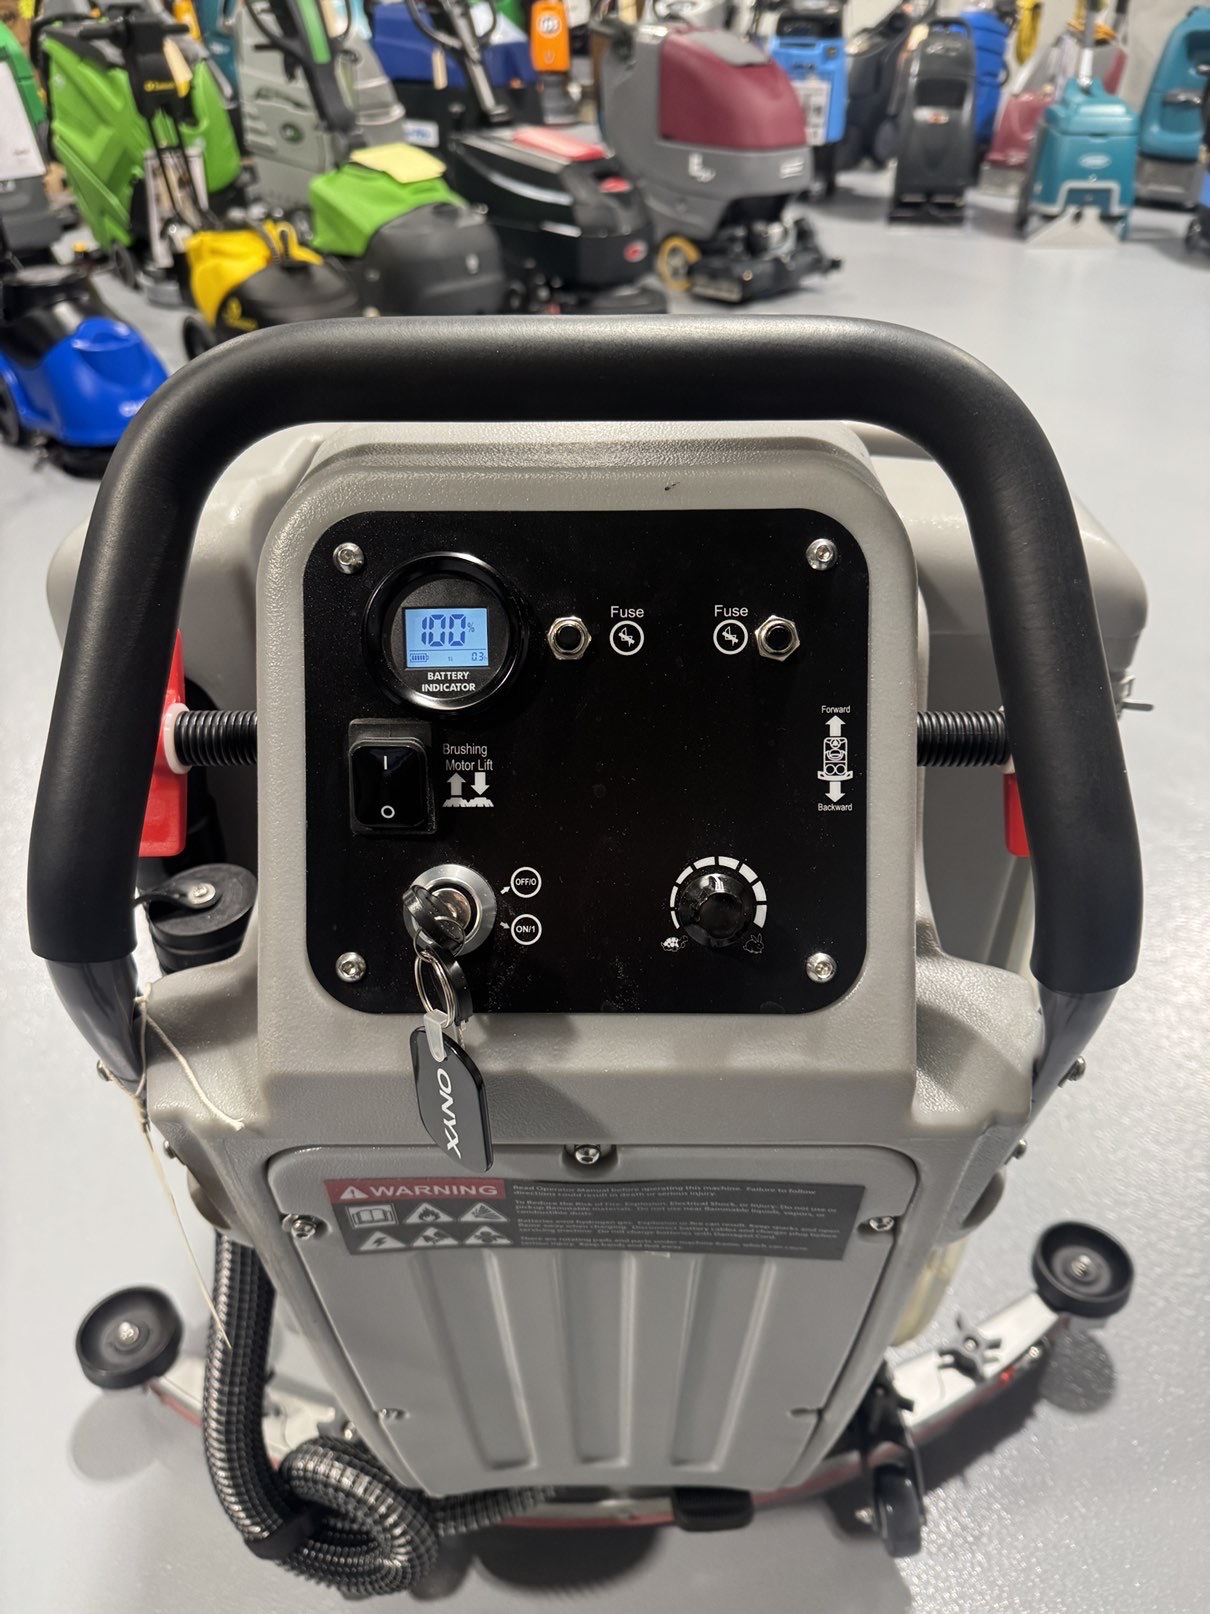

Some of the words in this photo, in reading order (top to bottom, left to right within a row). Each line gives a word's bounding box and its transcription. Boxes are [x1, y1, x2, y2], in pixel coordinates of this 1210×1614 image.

[610, 606, 645, 618] Fuse
[714, 605, 749, 617] Fuse
[427, 671, 470, 680] BATTERY
[421, 683, 476, 692] INDICATOR
[821, 705, 851, 713] Forward
[442, 743, 488, 758] Brushing
[445, 759, 475, 771] Motor
[477, 759, 494, 771] Lift
[817, 803, 853, 811] Backward
[436, 1067, 462, 1159] ONYX
[369, 1185, 498, 1197] WARNING
